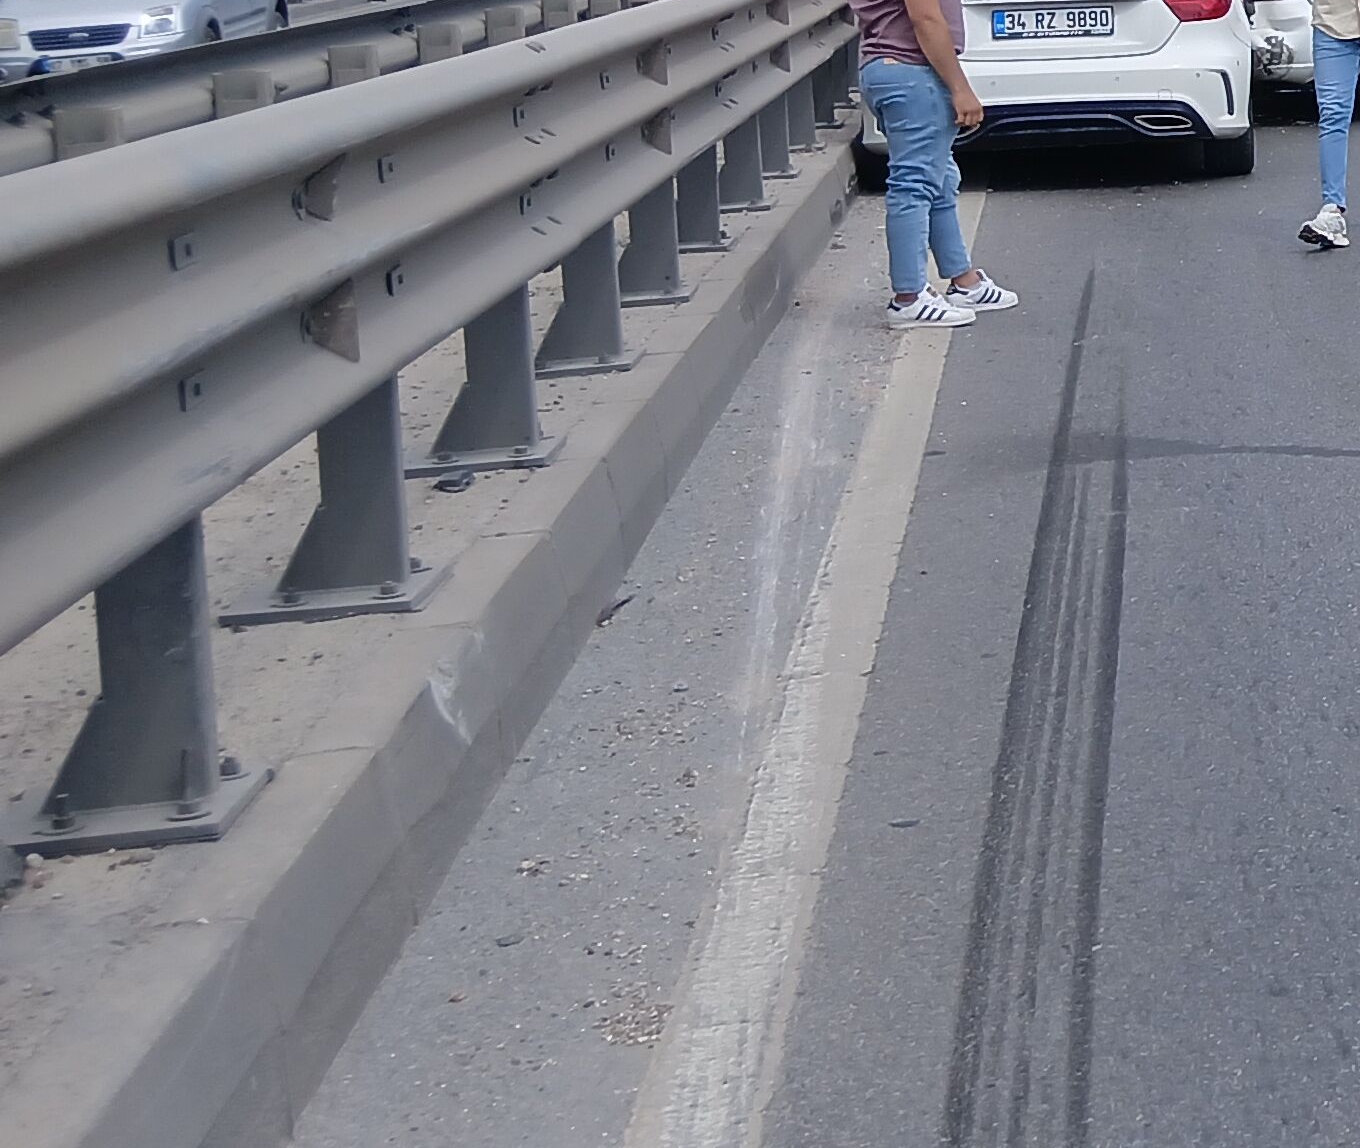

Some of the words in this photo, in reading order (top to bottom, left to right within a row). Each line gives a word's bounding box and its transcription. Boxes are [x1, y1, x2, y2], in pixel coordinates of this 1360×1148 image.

[1005, 13, 1027, 31] 34
[1035, 11, 1057, 30] RZ
[1066, 9, 1110, 29] 9890
